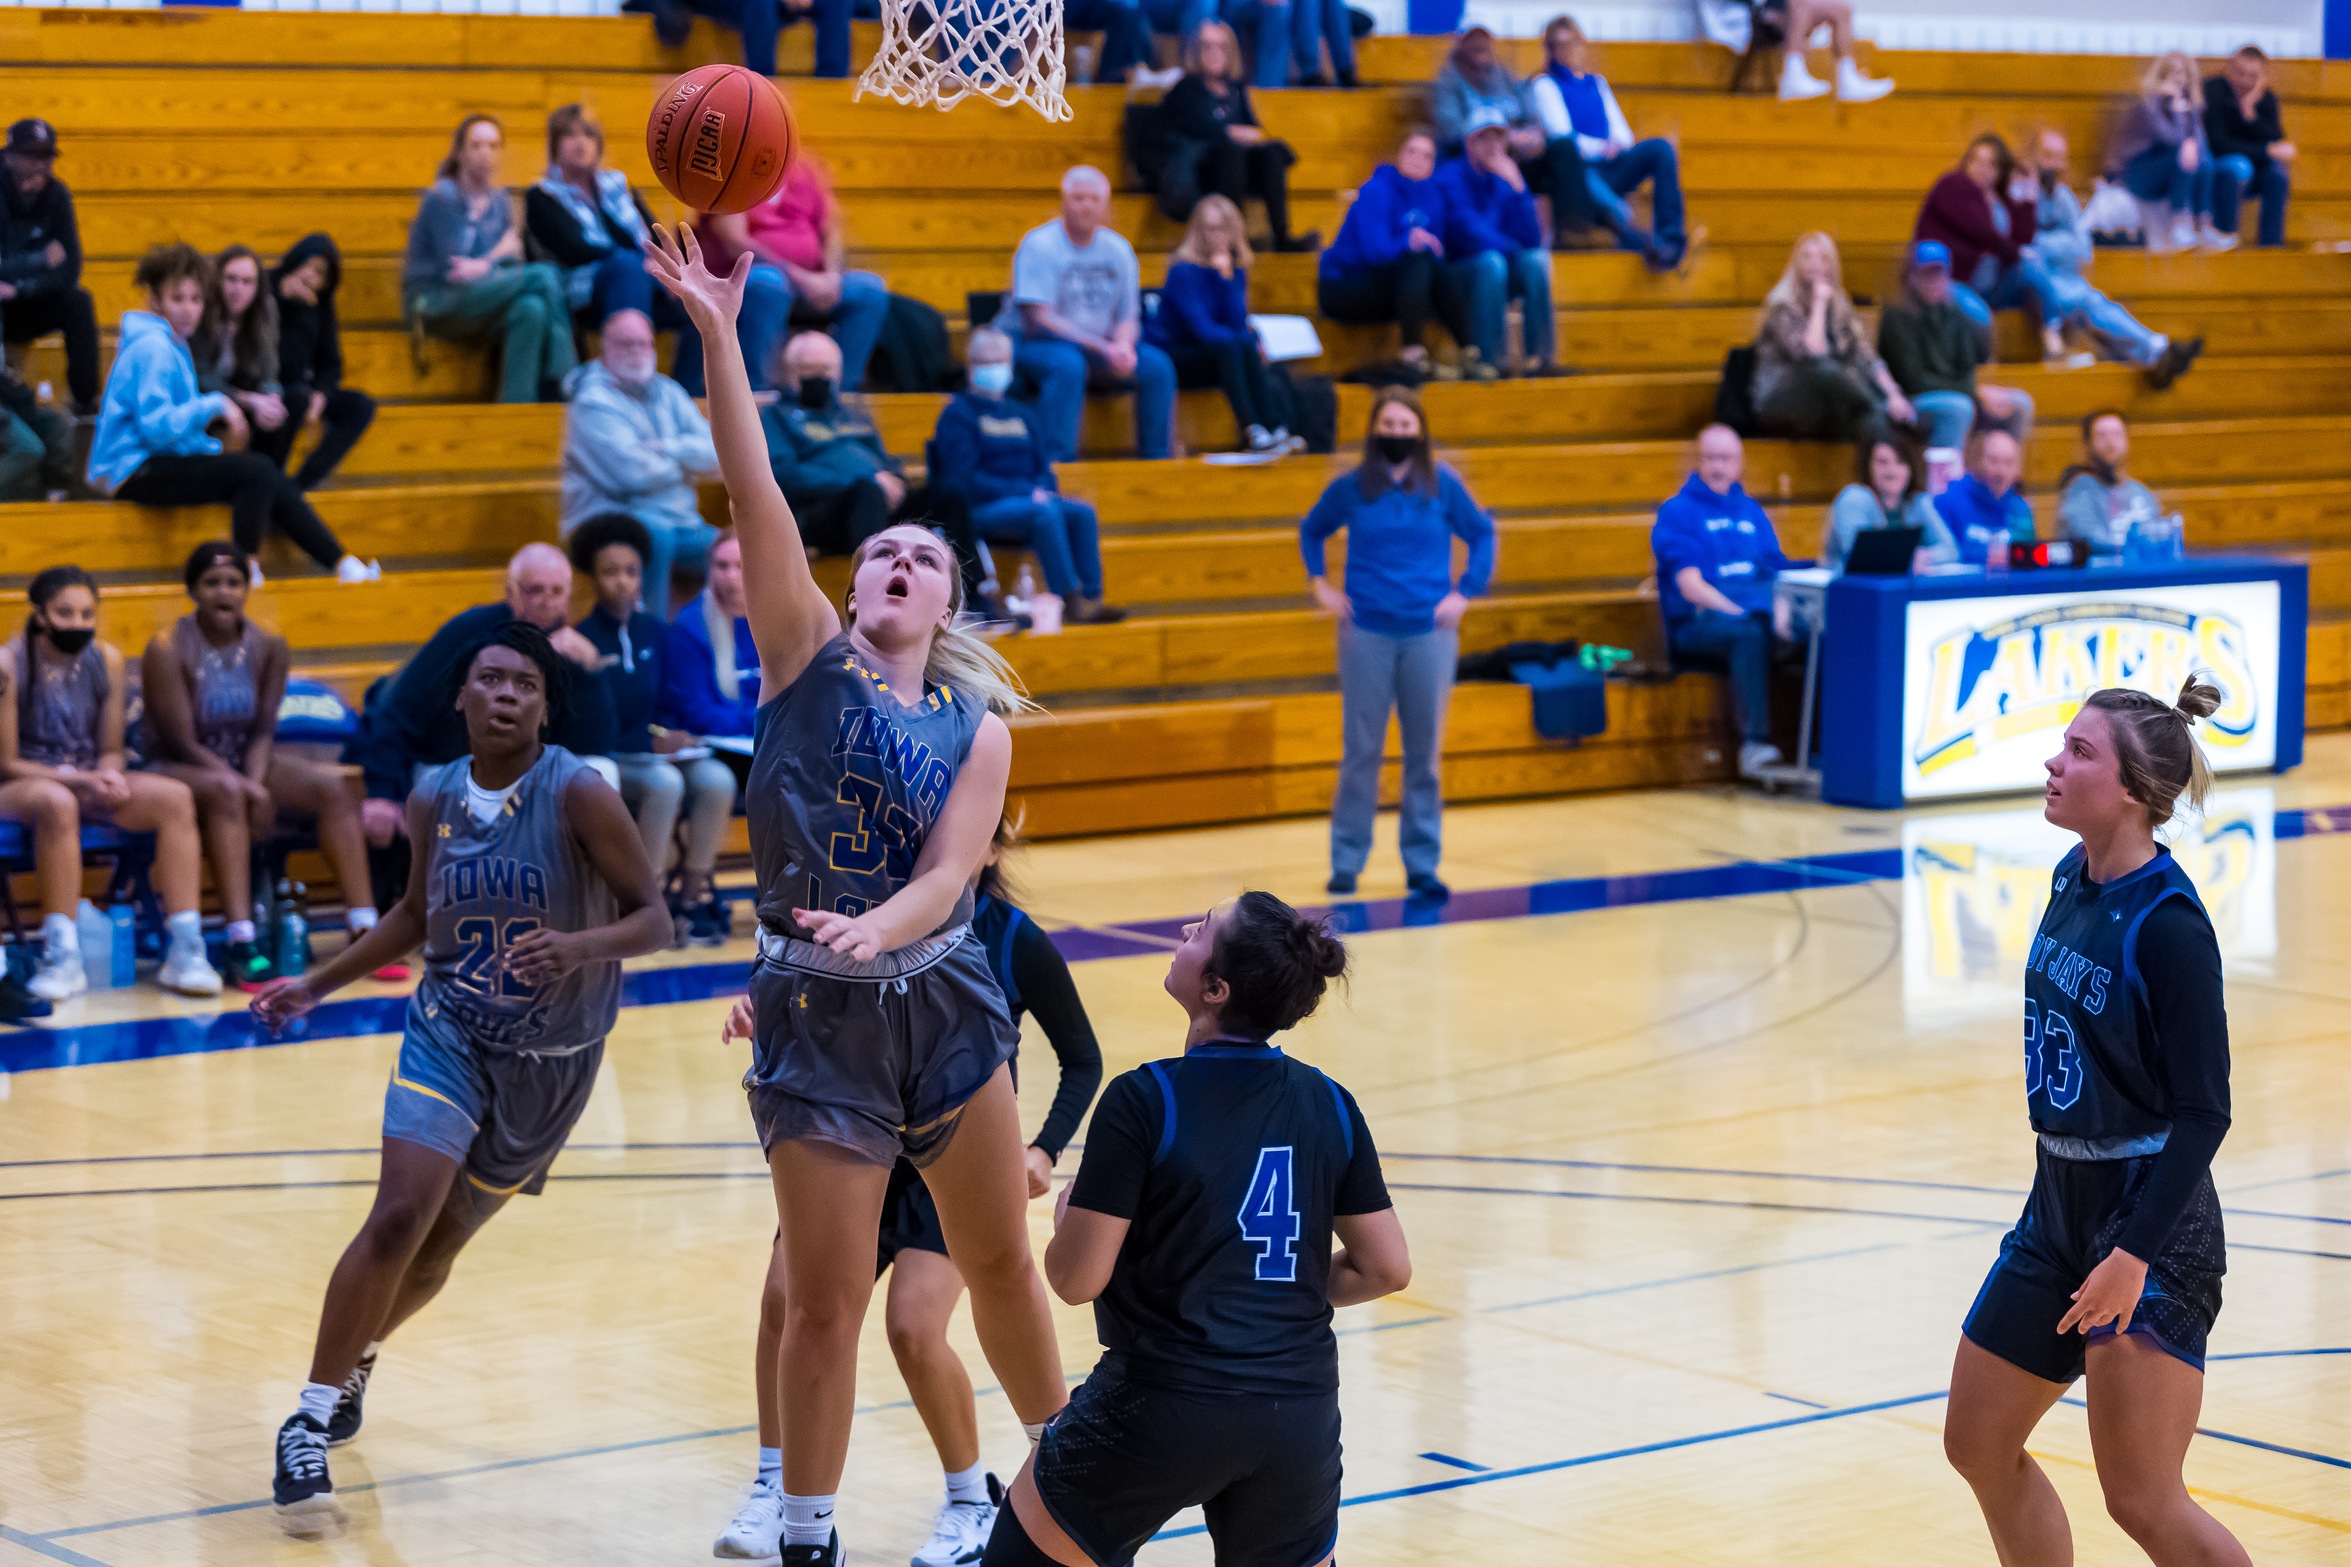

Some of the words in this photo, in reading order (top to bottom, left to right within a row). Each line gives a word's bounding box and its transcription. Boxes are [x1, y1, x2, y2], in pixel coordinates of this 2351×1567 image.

[655, 80, 704, 175] SPALDING
[688, 110, 724, 179] NJCAA
[1914, 614, 2256, 776] LAKERS
[831, 706, 950, 823] IOWA
[442, 856, 549, 912] IOWA
[1237, 1146, 1300, 1281] 4
